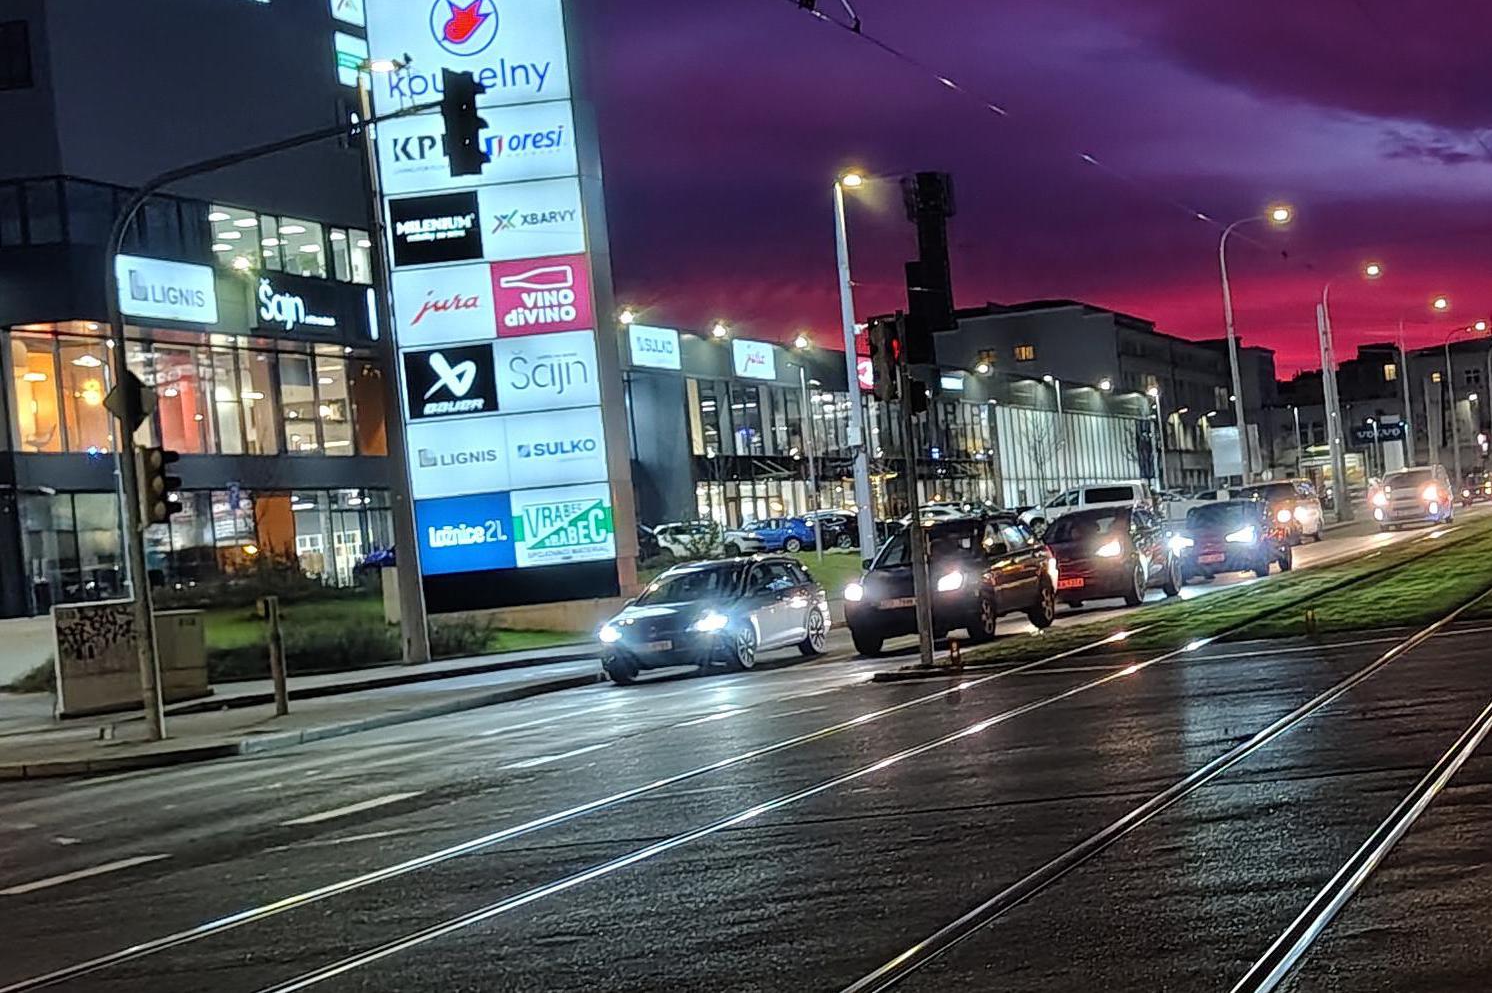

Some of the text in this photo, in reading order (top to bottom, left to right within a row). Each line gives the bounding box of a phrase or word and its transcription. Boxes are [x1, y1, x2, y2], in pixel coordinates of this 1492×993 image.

[389, 58, 551, 98] kouelny
[392, 134, 447, 162] KP
[508, 125, 564, 151] oresi
[521, 209, 576, 226] XBARVY
[151, 284, 206, 308] LIGNIS
[521, 288, 576, 309] VINO
[411, 290, 479, 326] jura
[504, 305, 577, 327] diVINO
[440, 449, 497, 466] LIGNIS
[533, 438, 597, 457] SULKO
